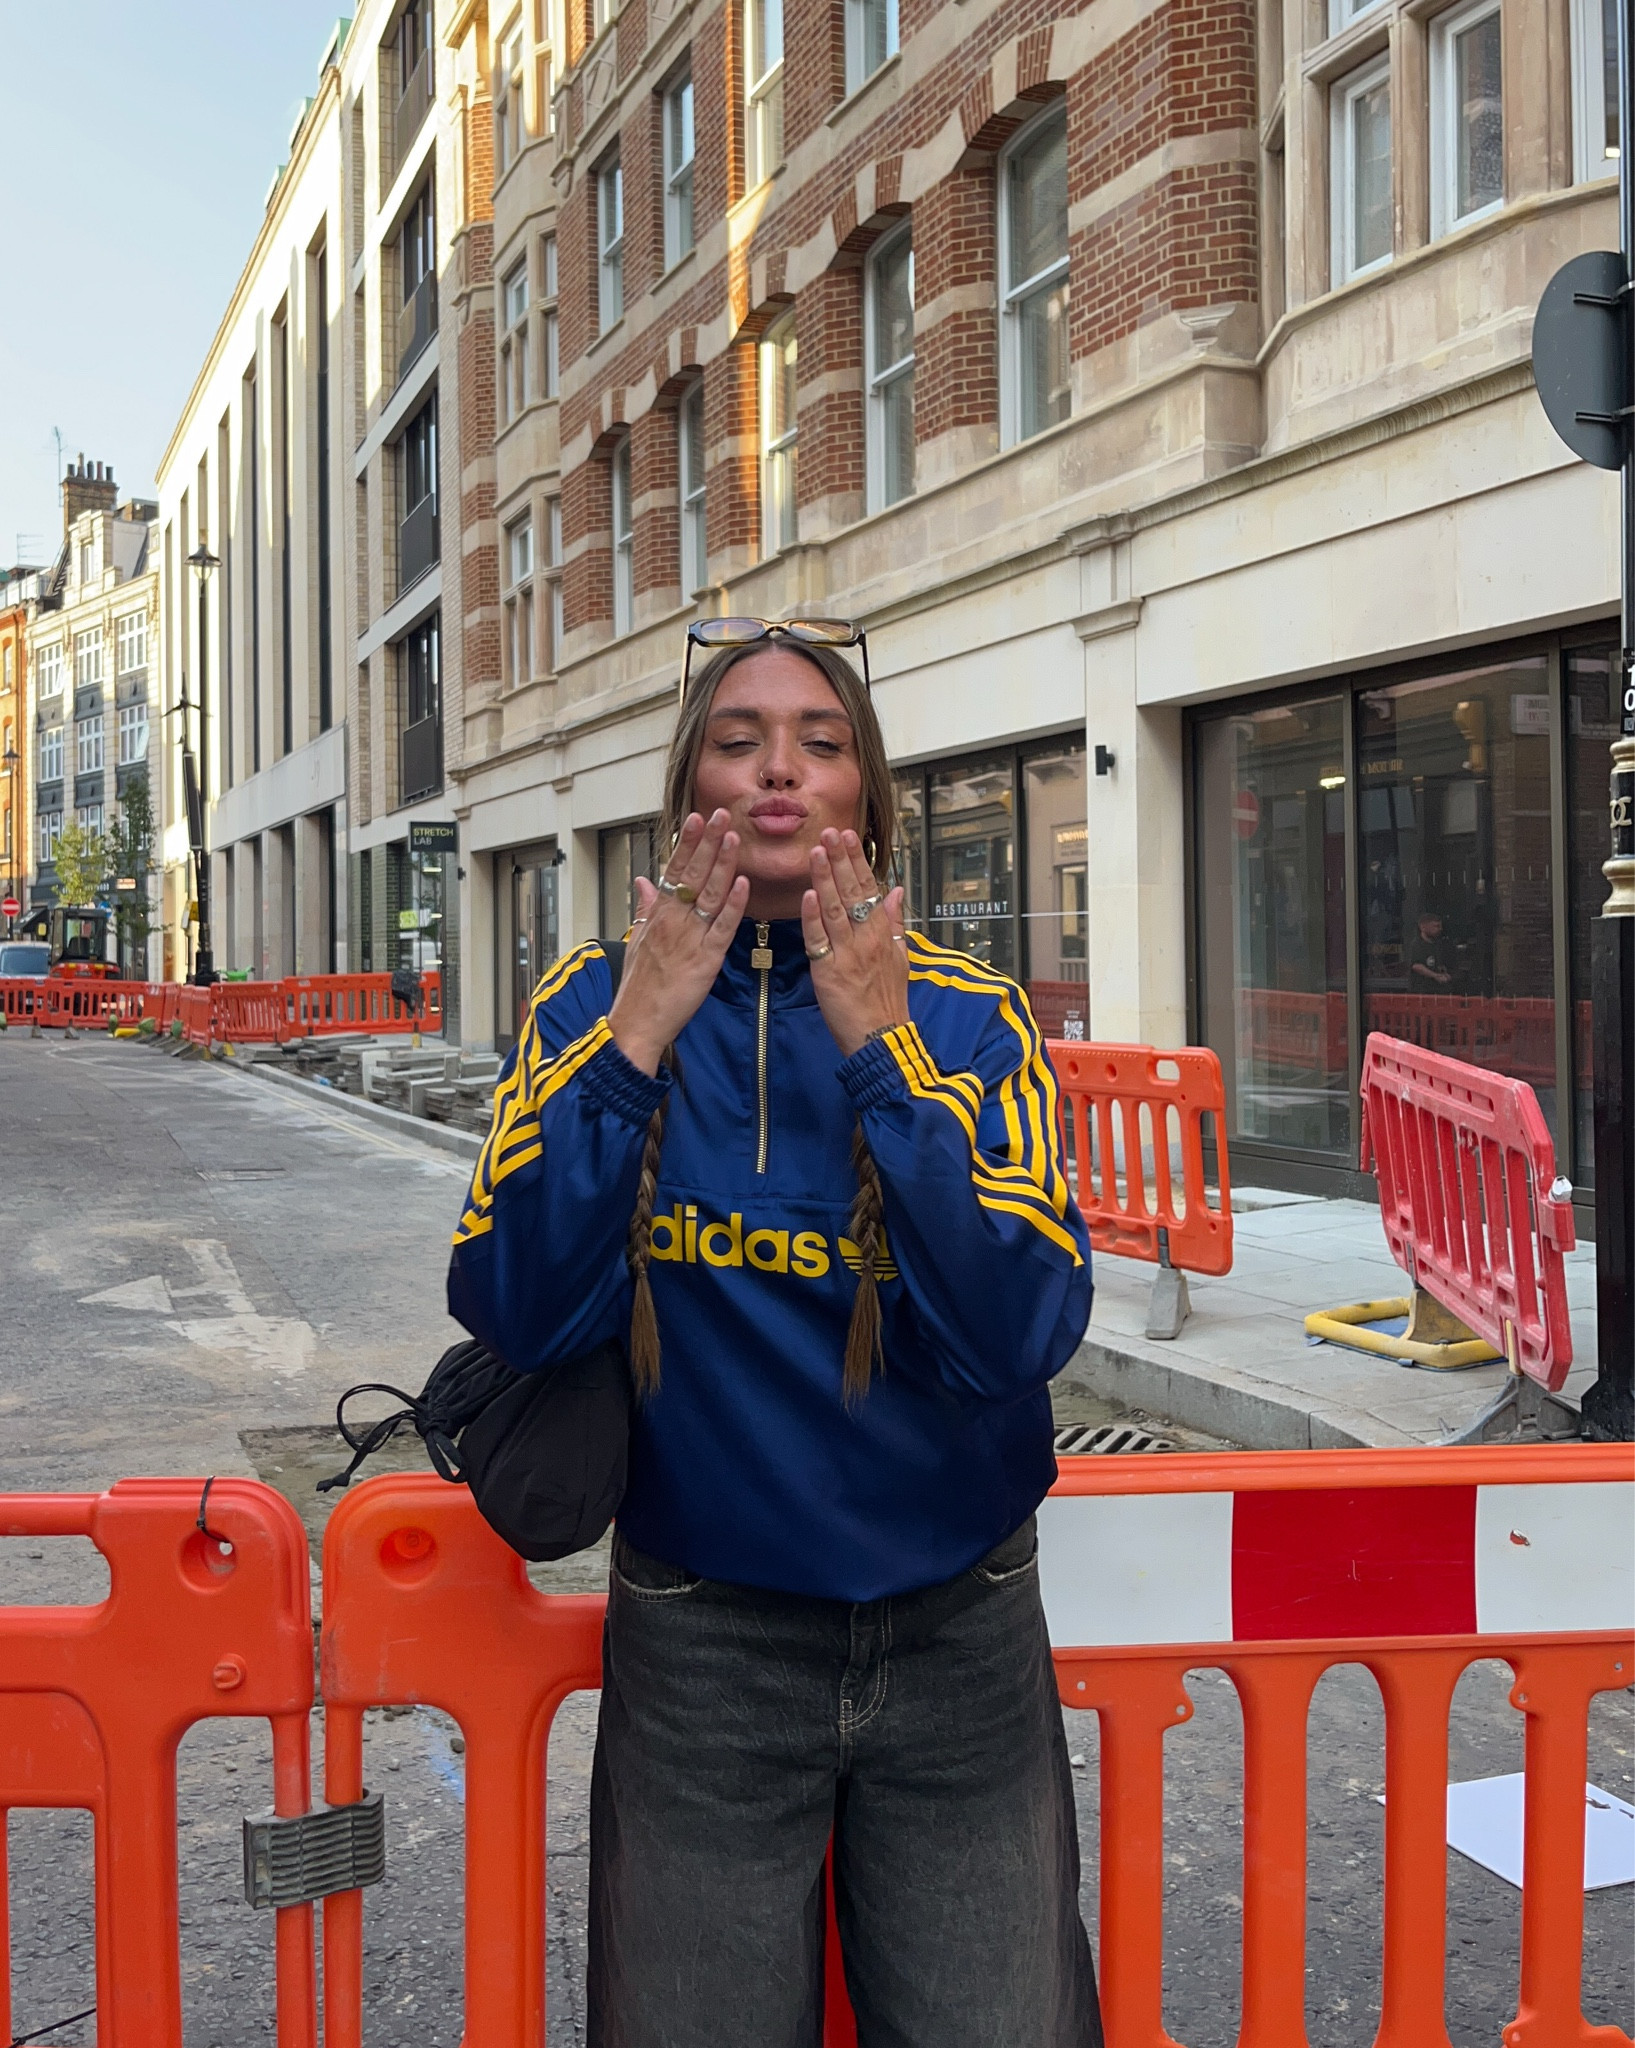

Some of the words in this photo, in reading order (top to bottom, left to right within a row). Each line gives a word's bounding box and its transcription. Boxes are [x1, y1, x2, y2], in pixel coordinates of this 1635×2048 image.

[413, 827, 454, 837] STRETCH
[414, 836, 432, 845] LAB
[935, 901, 1008, 916] RESTAURANT
[650, 1203, 830, 1278] didas
